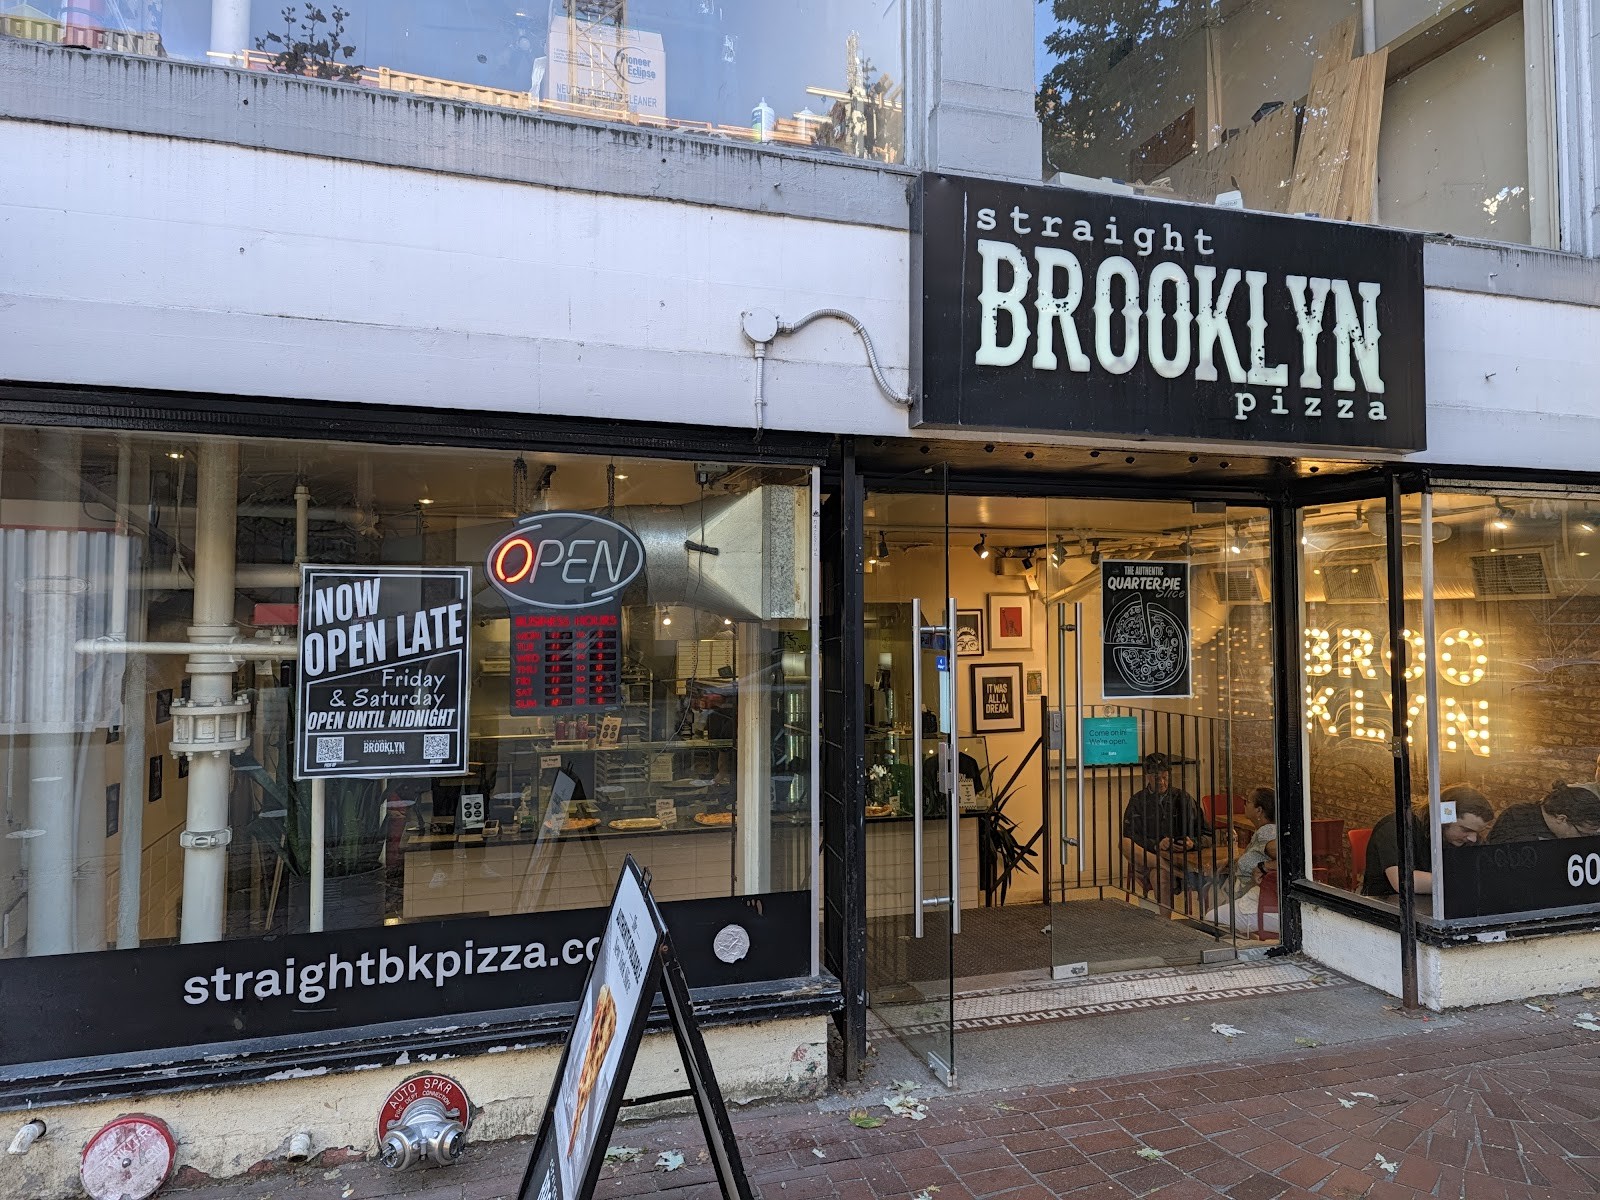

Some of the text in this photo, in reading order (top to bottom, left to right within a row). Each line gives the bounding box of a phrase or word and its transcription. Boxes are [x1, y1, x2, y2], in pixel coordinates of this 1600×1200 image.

[627, 64, 656, 79] Eclipse
[977, 205, 1215, 256] straight
[975, 238, 1385, 394] BROOKLYN
[1234, 387, 1388, 421] pizza
[496, 538, 629, 584] OPEN
[1124, 566, 1164, 576] THE AUTHENTIC
[1107, 576, 1182, 591] QUARTER PIE
[1155, 586, 1186, 598] Slice
[315, 578, 381, 626] NOW
[574, 615, 617, 626] HOURS
[304, 603, 463, 677] OPEN LATE
[381, 668, 446, 693] Friday
[986, 684, 1008, 694] IT WAS
[329, 688, 446, 711] & Saturday
[986, 704, 1009, 714] DREAM
[988, 694, 1001, 704] ALL
[307, 708, 456, 730] OPEN UNTIL MIDNIGHT
[363, 741, 406, 753] BROOKLYN
[389, 1078, 453, 1110] AUTO SPKR
[394, 1090, 451, 1118] FIRE DEPT CONNECTION
